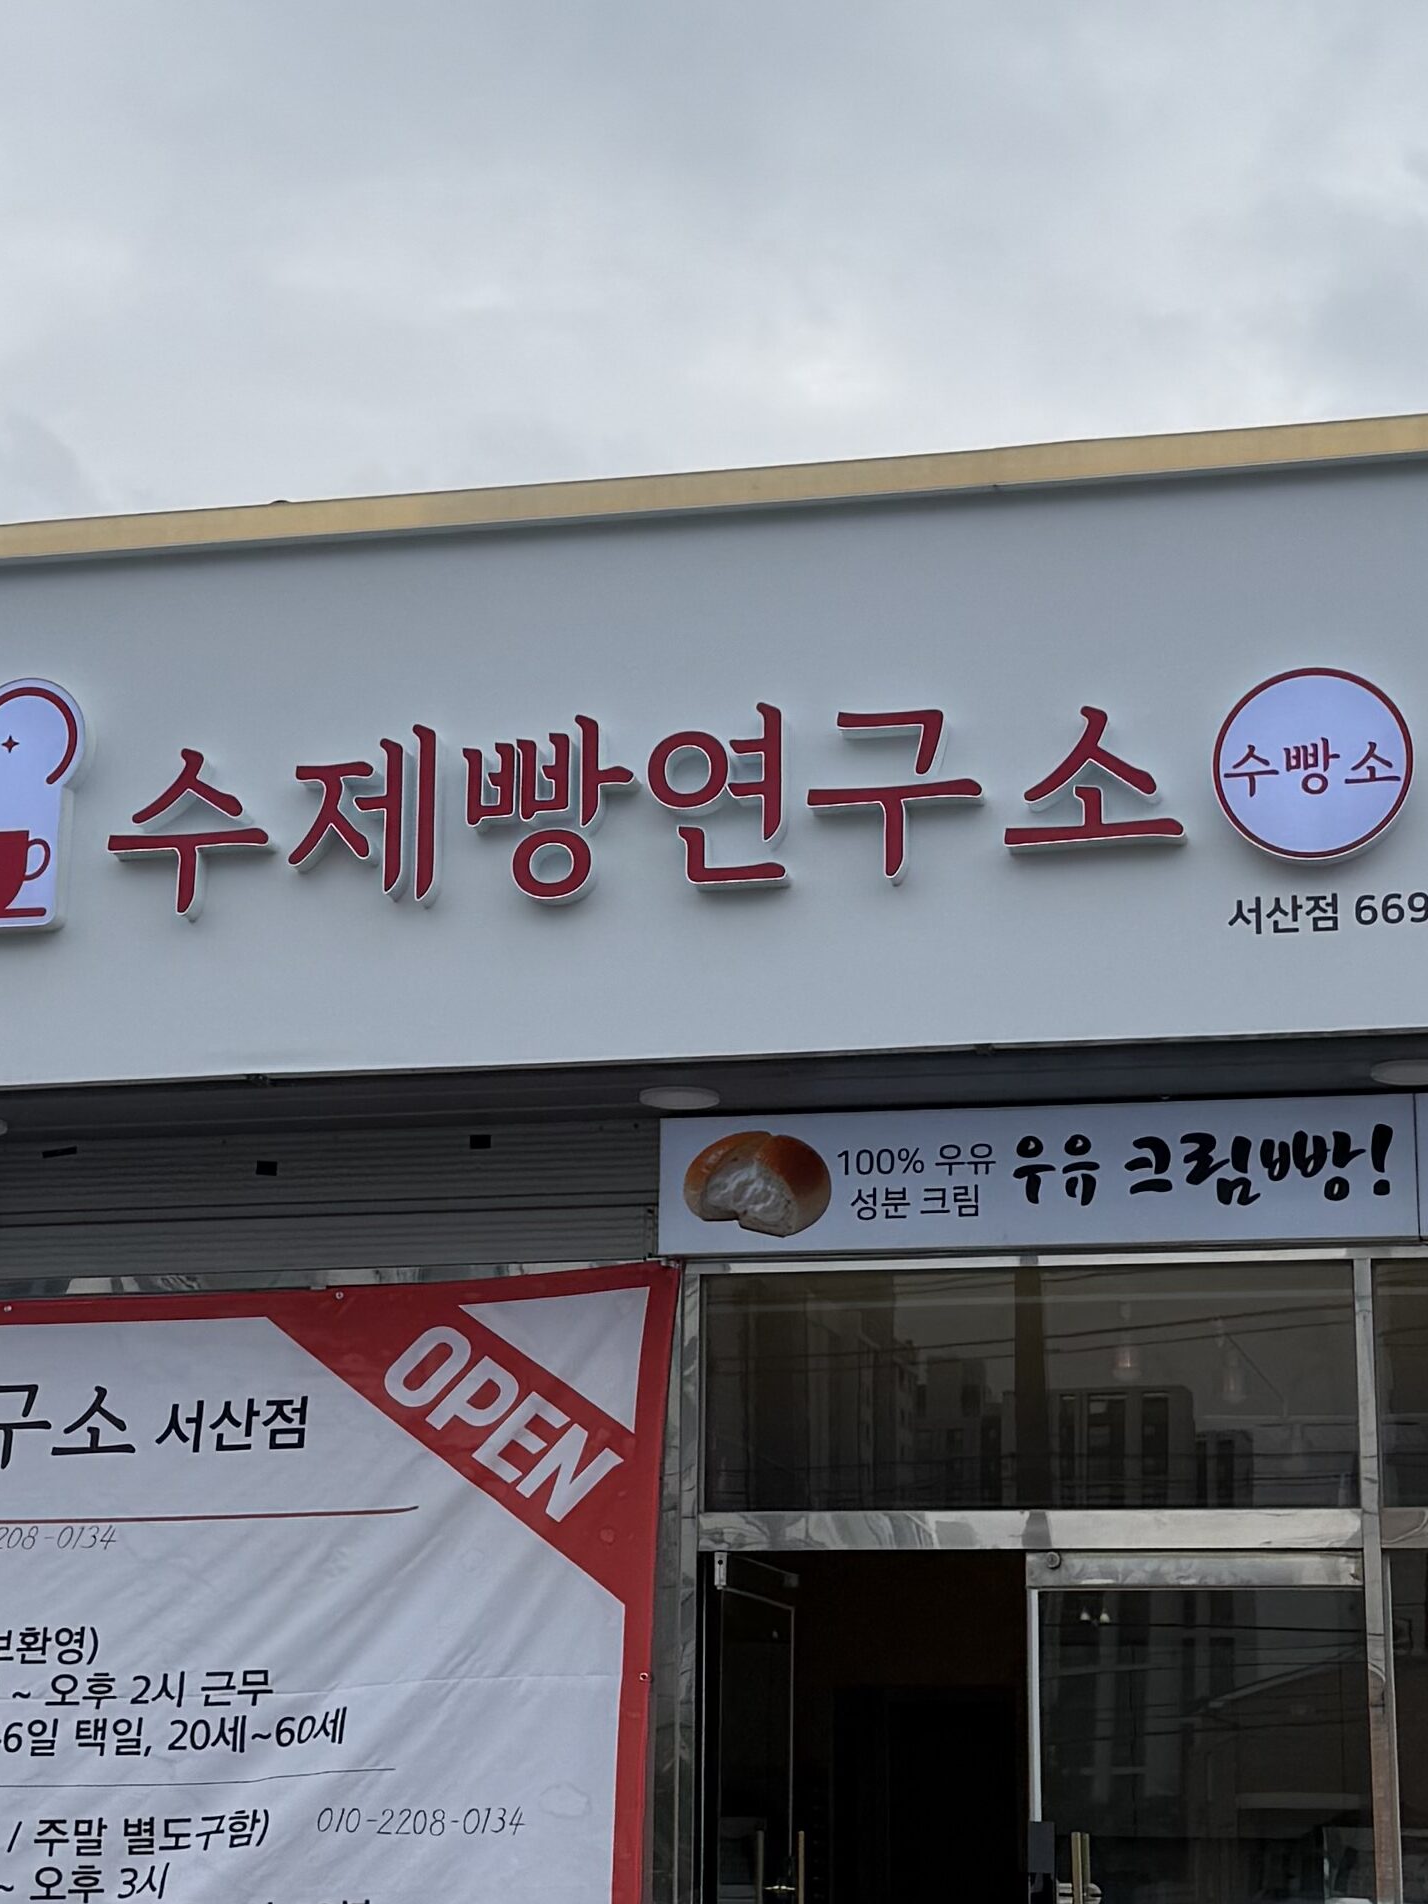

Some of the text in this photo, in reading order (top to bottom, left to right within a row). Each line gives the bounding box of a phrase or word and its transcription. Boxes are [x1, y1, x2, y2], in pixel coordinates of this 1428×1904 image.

[1222, 737, 1402, 797] 수빵소
[108, 704, 1183, 912] 수제빵연구소
[1228, 893, 1338, 934] 서산점
[838, 1144, 996, 1176] 100% 우유
[1013, 1124, 1393, 1206] 우유 크림빵!
[851, 1184, 978, 1220] 성분 크림
[156, 1396, 308, 1452] 서산점
[384, 1325, 625, 1524] OPEN
[45, 1673, 117, 1708] 오후
[130, 1671, 185, 1707] 2시
[201, 1670, 273, 1706] 근무
[76, 1717, 151, 1757] 택일,
[168, 1706, 347, 1753] 20세~60세
[34, 1818, 107, 1857] 주말
[124, 1809, 269, 1855] 별도구함)
[317, 1807, 525, 1836] 010-2208-0134
[30, 1865, 104, 1903] 오후
[118, 1863, 170, 1899] 3시
